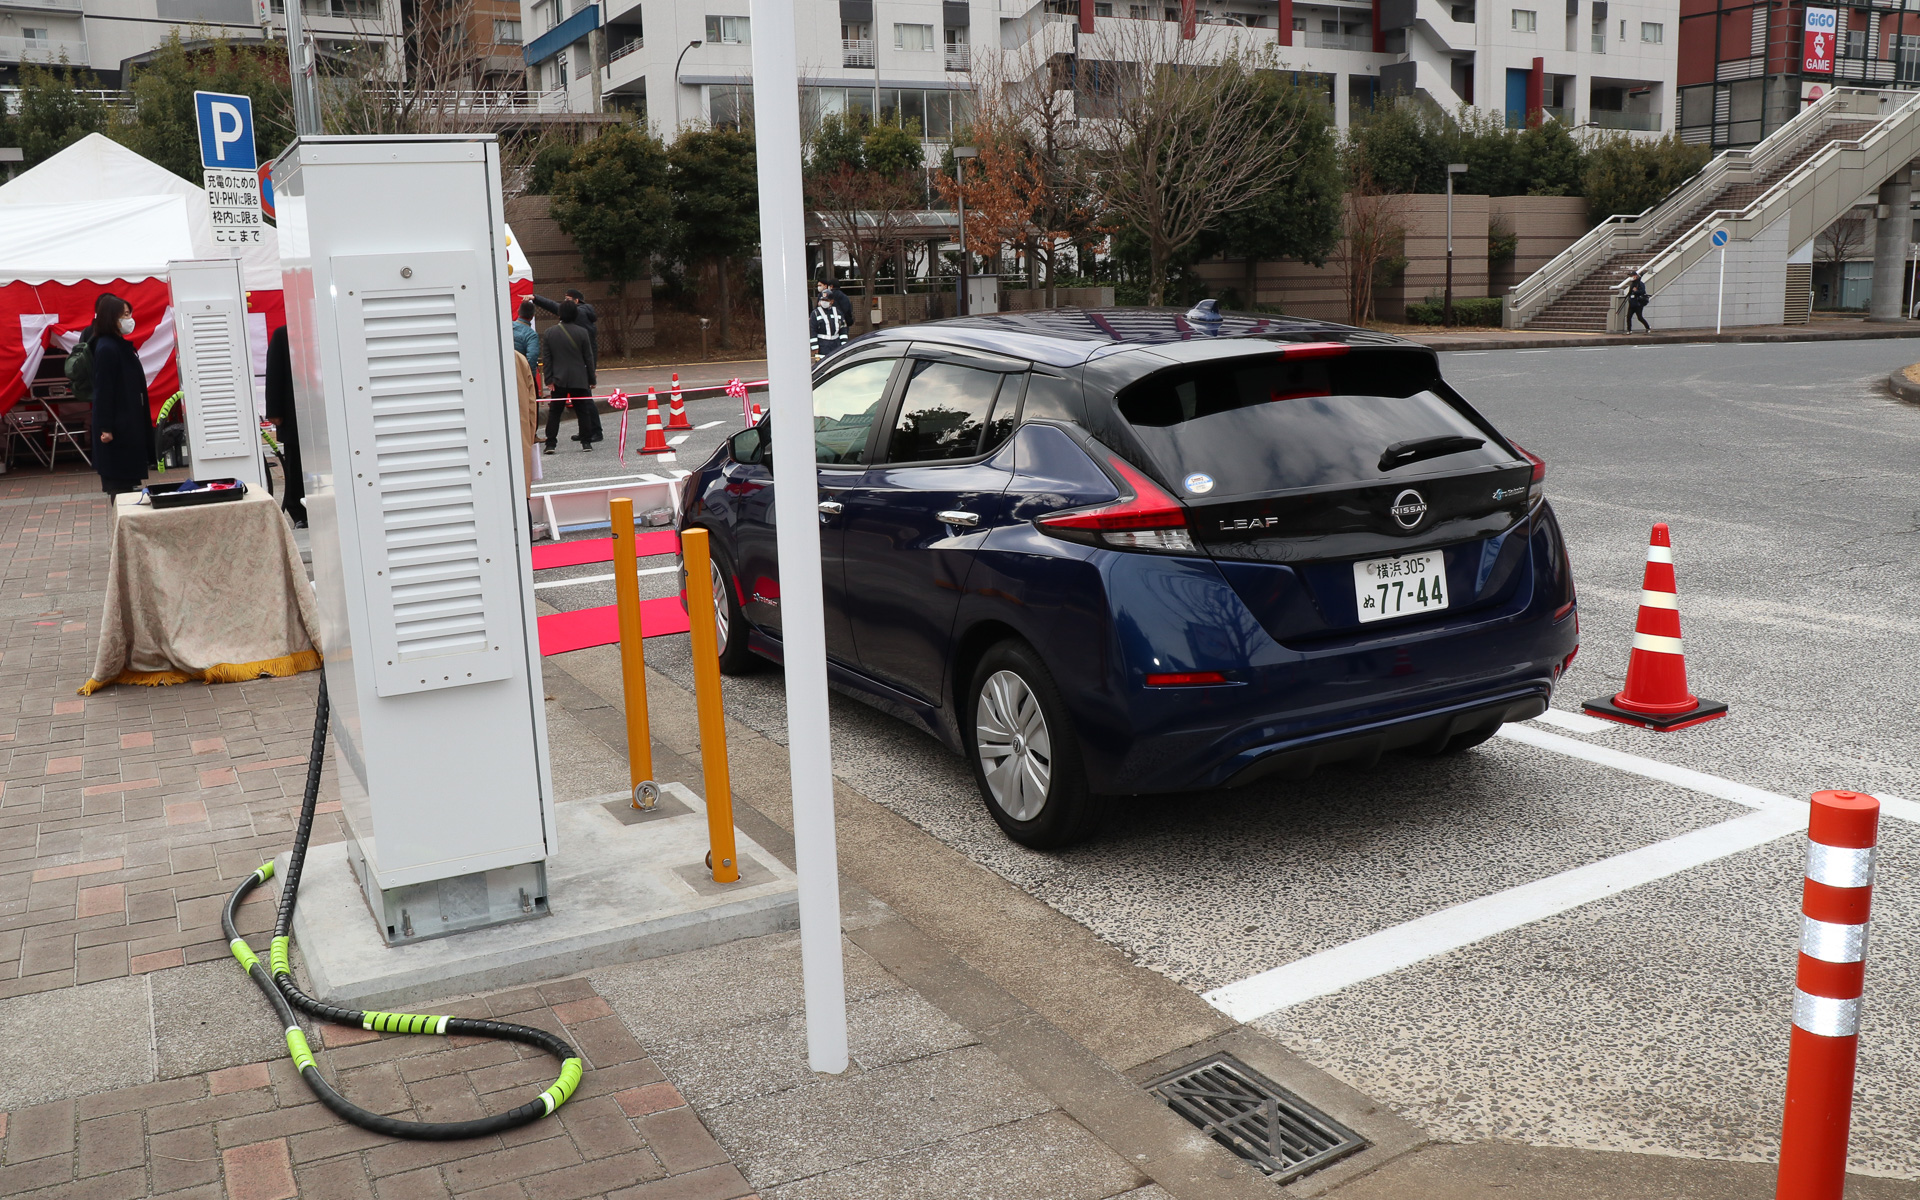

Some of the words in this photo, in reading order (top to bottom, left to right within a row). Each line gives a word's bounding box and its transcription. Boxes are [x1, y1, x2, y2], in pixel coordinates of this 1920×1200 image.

[1808, 13, 1834, 27] GiGO
[1806, 58, 1830, 71] GAME
[211, 101, 243, 161] P
[207, 175, 257, 189] 充電のための
[212, 210, 259, 224] 枠内に限る
[216, 230, 260, 242] ここまで
[1391, 504, 1427, 515] NISSAN
[1219, 517, 1278, 531] LEAF
[1363, 594, 1376, 609] ぬ
[1376, 574, 1443, 614] 77-44
